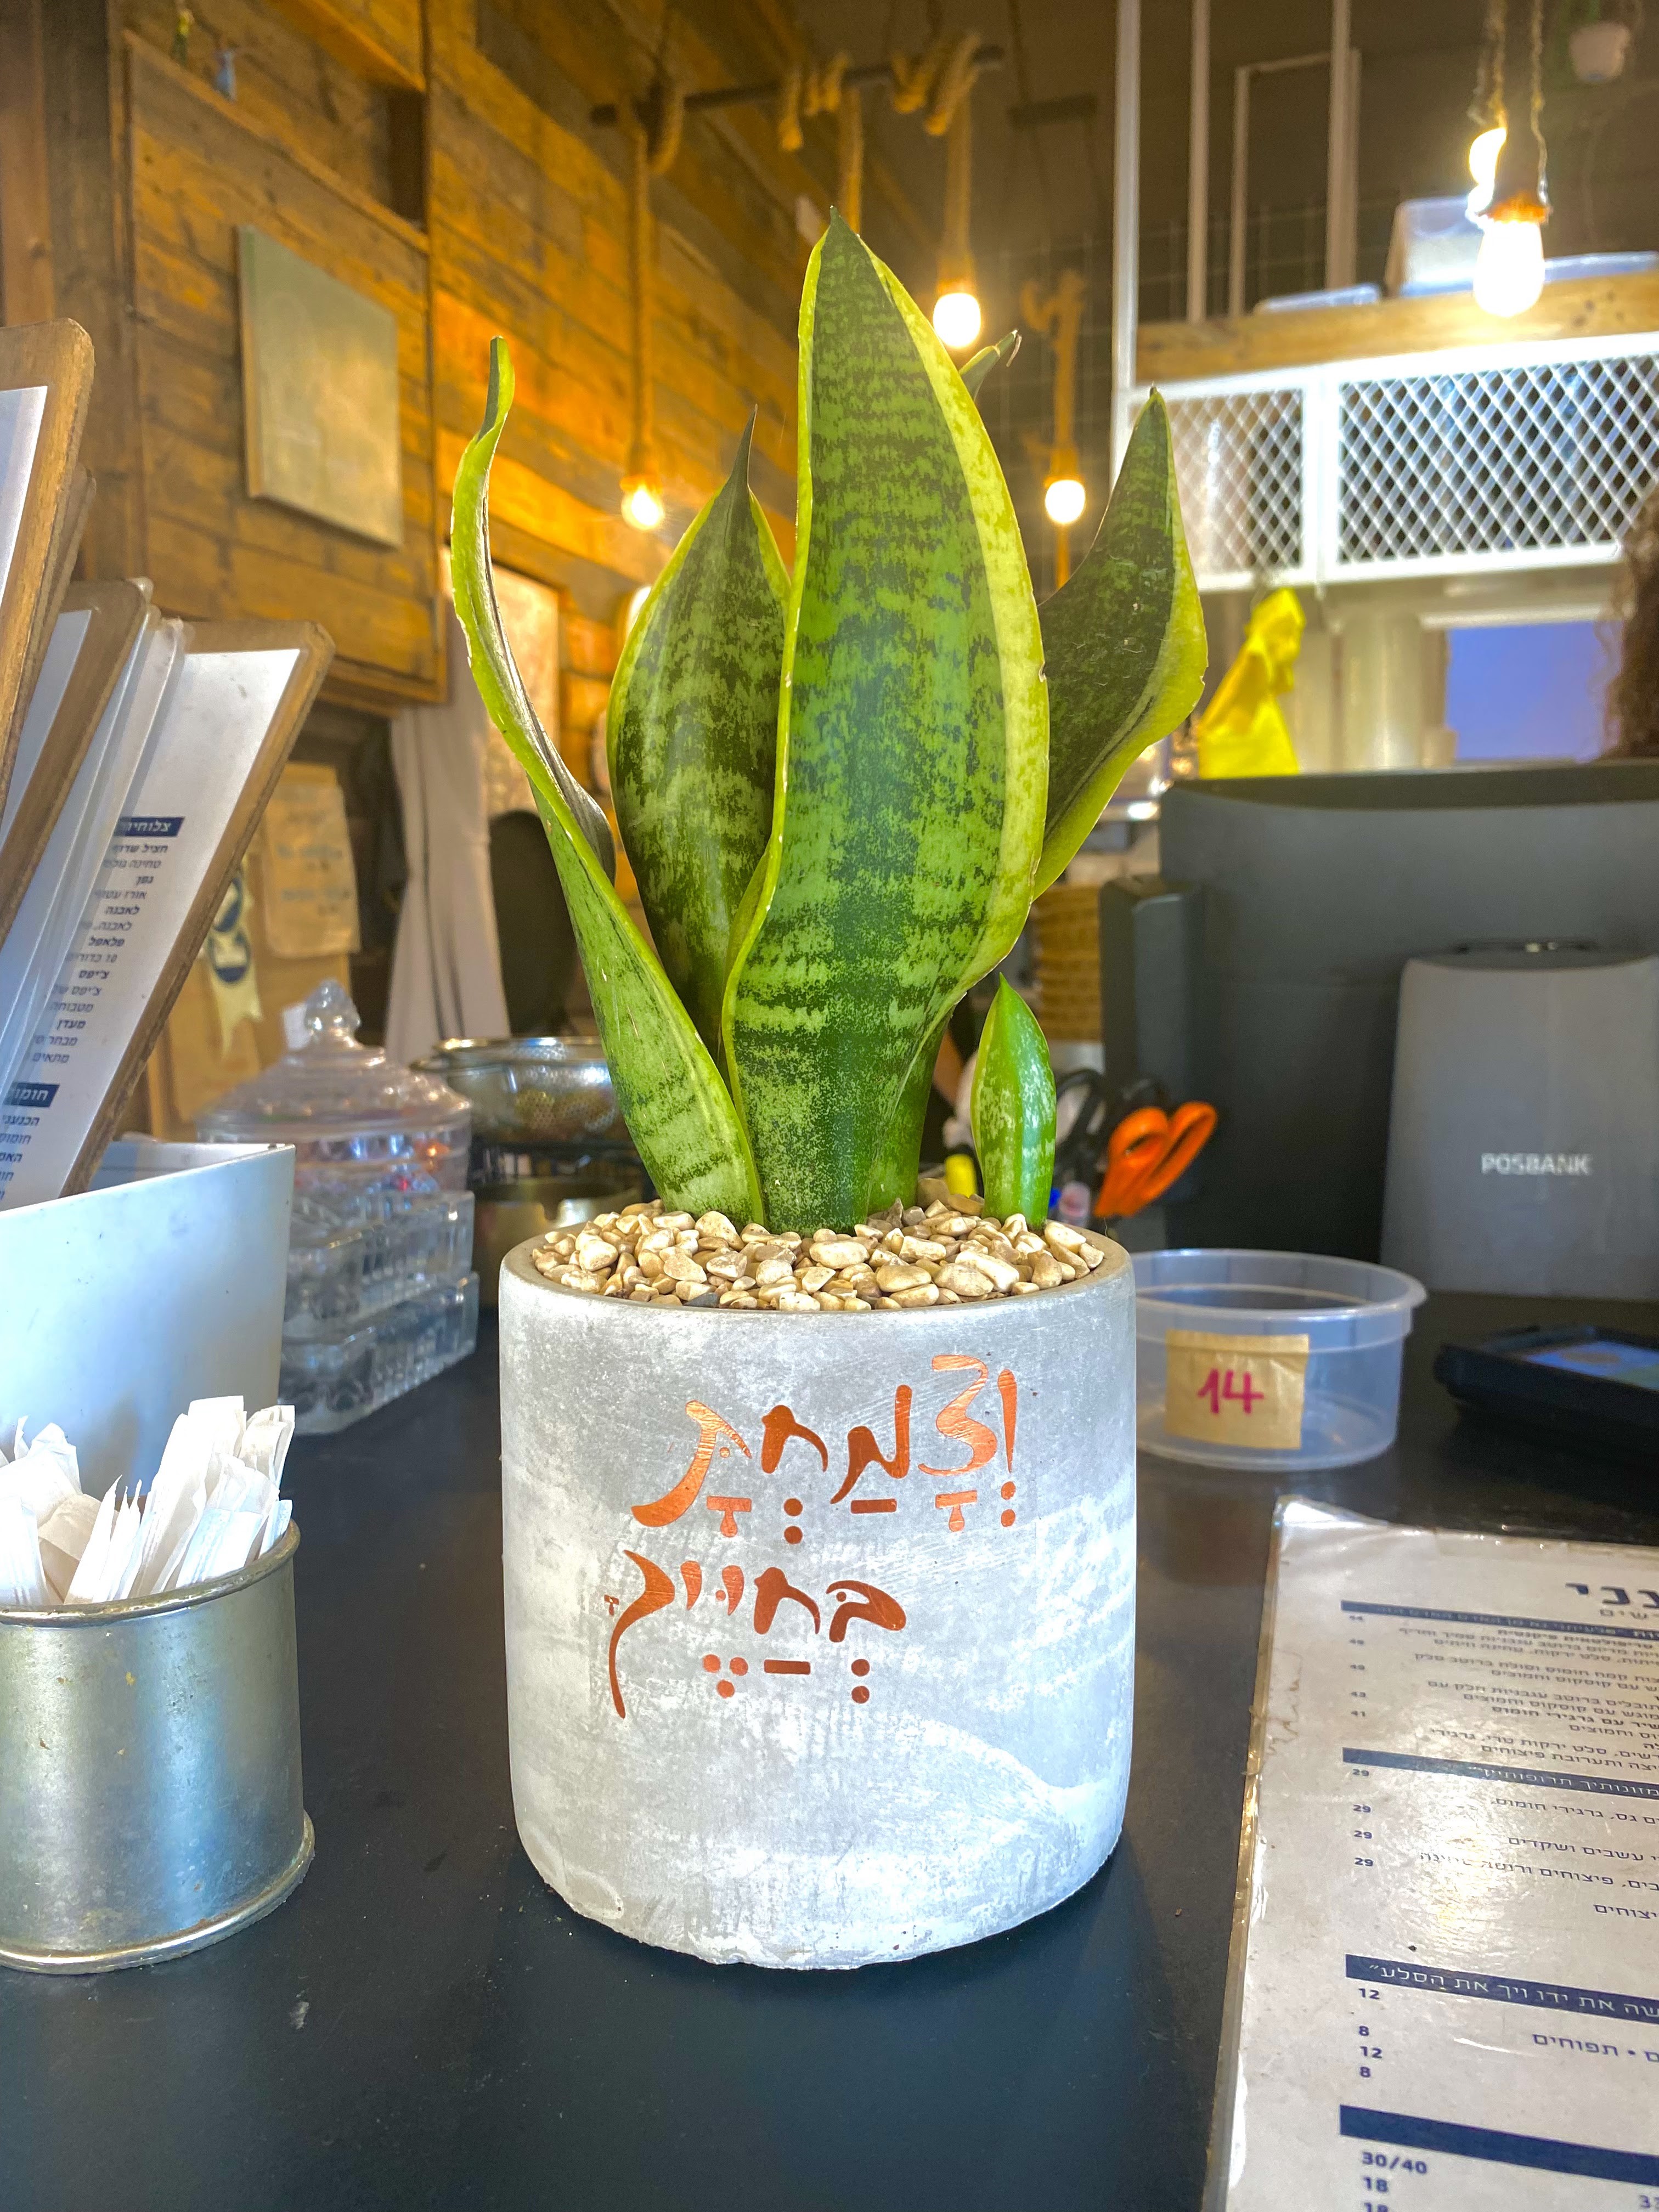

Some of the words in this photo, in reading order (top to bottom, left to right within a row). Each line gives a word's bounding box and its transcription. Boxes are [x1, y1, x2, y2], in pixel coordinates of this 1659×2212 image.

[88, 935, 125, 946] פלאפל
[1481, 1153, 1592, 1175] POSBANK
[1197, 1369, 1264, 1414] 14
[1545, 1667, 1589, 1675] חומוס
[1556, 1676, 1611, 1688] קוסקוס
[1492, 1687, 1548, 1699] עגבניות
[1554, 1694, 1600, 1704] ברוטב
[1463, 1693, 1523, 1706] וחמוצים
[1606, 1700, 1659, 1711] תובלים
[1492, 1706, 1539, 1717] חומוס
[1530, 1701, 1587, 1713] קוסקוס
[1546, 1712, 1594, 1723] גרגירי
[1430, 1729, 1476, 1740] גרגירי
[1569, 1724, 1633, 1737] וחמוצים
[1521, 1739, 1566, 1750] ירקות
[1572, 1745, 1607, 1754] סלט
[1481, 1745, 1545, 1759] פיצוחים
[1552, 1753, 1622, 1768] ותערובת
[1353, 1804, 1371, 1813] 29
[1553, 1805, 1604, 1818] גרגירי
[1354, 1830, 1373, 1839] 29
[1508, 1837, 1576, 1853] ושקדים
[1582, 1847, 1644, 1860] עשבים
[1355, 1857, 1374, 1866] 29
[1539, 1869, 1613, 1884] פיצוחים
[1593, 1904, 1659, 1920] יצוחים
[1454, 1978, 1489, 1992] את
[1358, 1988, 1380, 2000] 12
[1497, 1984, 1528, 1999] ויך
[1537, 1990, 1568, 2002] ידו
[1579, 1997, 1615, 2011] את
[1358, 2025, 1369, 2036] 8
[1532, 2034, 1618, 2056] תפוחים
[1360, 2046, 1383, 2059] 12
[1360, 2066, 1371, 2078] 8
[1362, 2151, 1427, 2174] 30/40
[1363, 2176, 1389, 2193] 18
